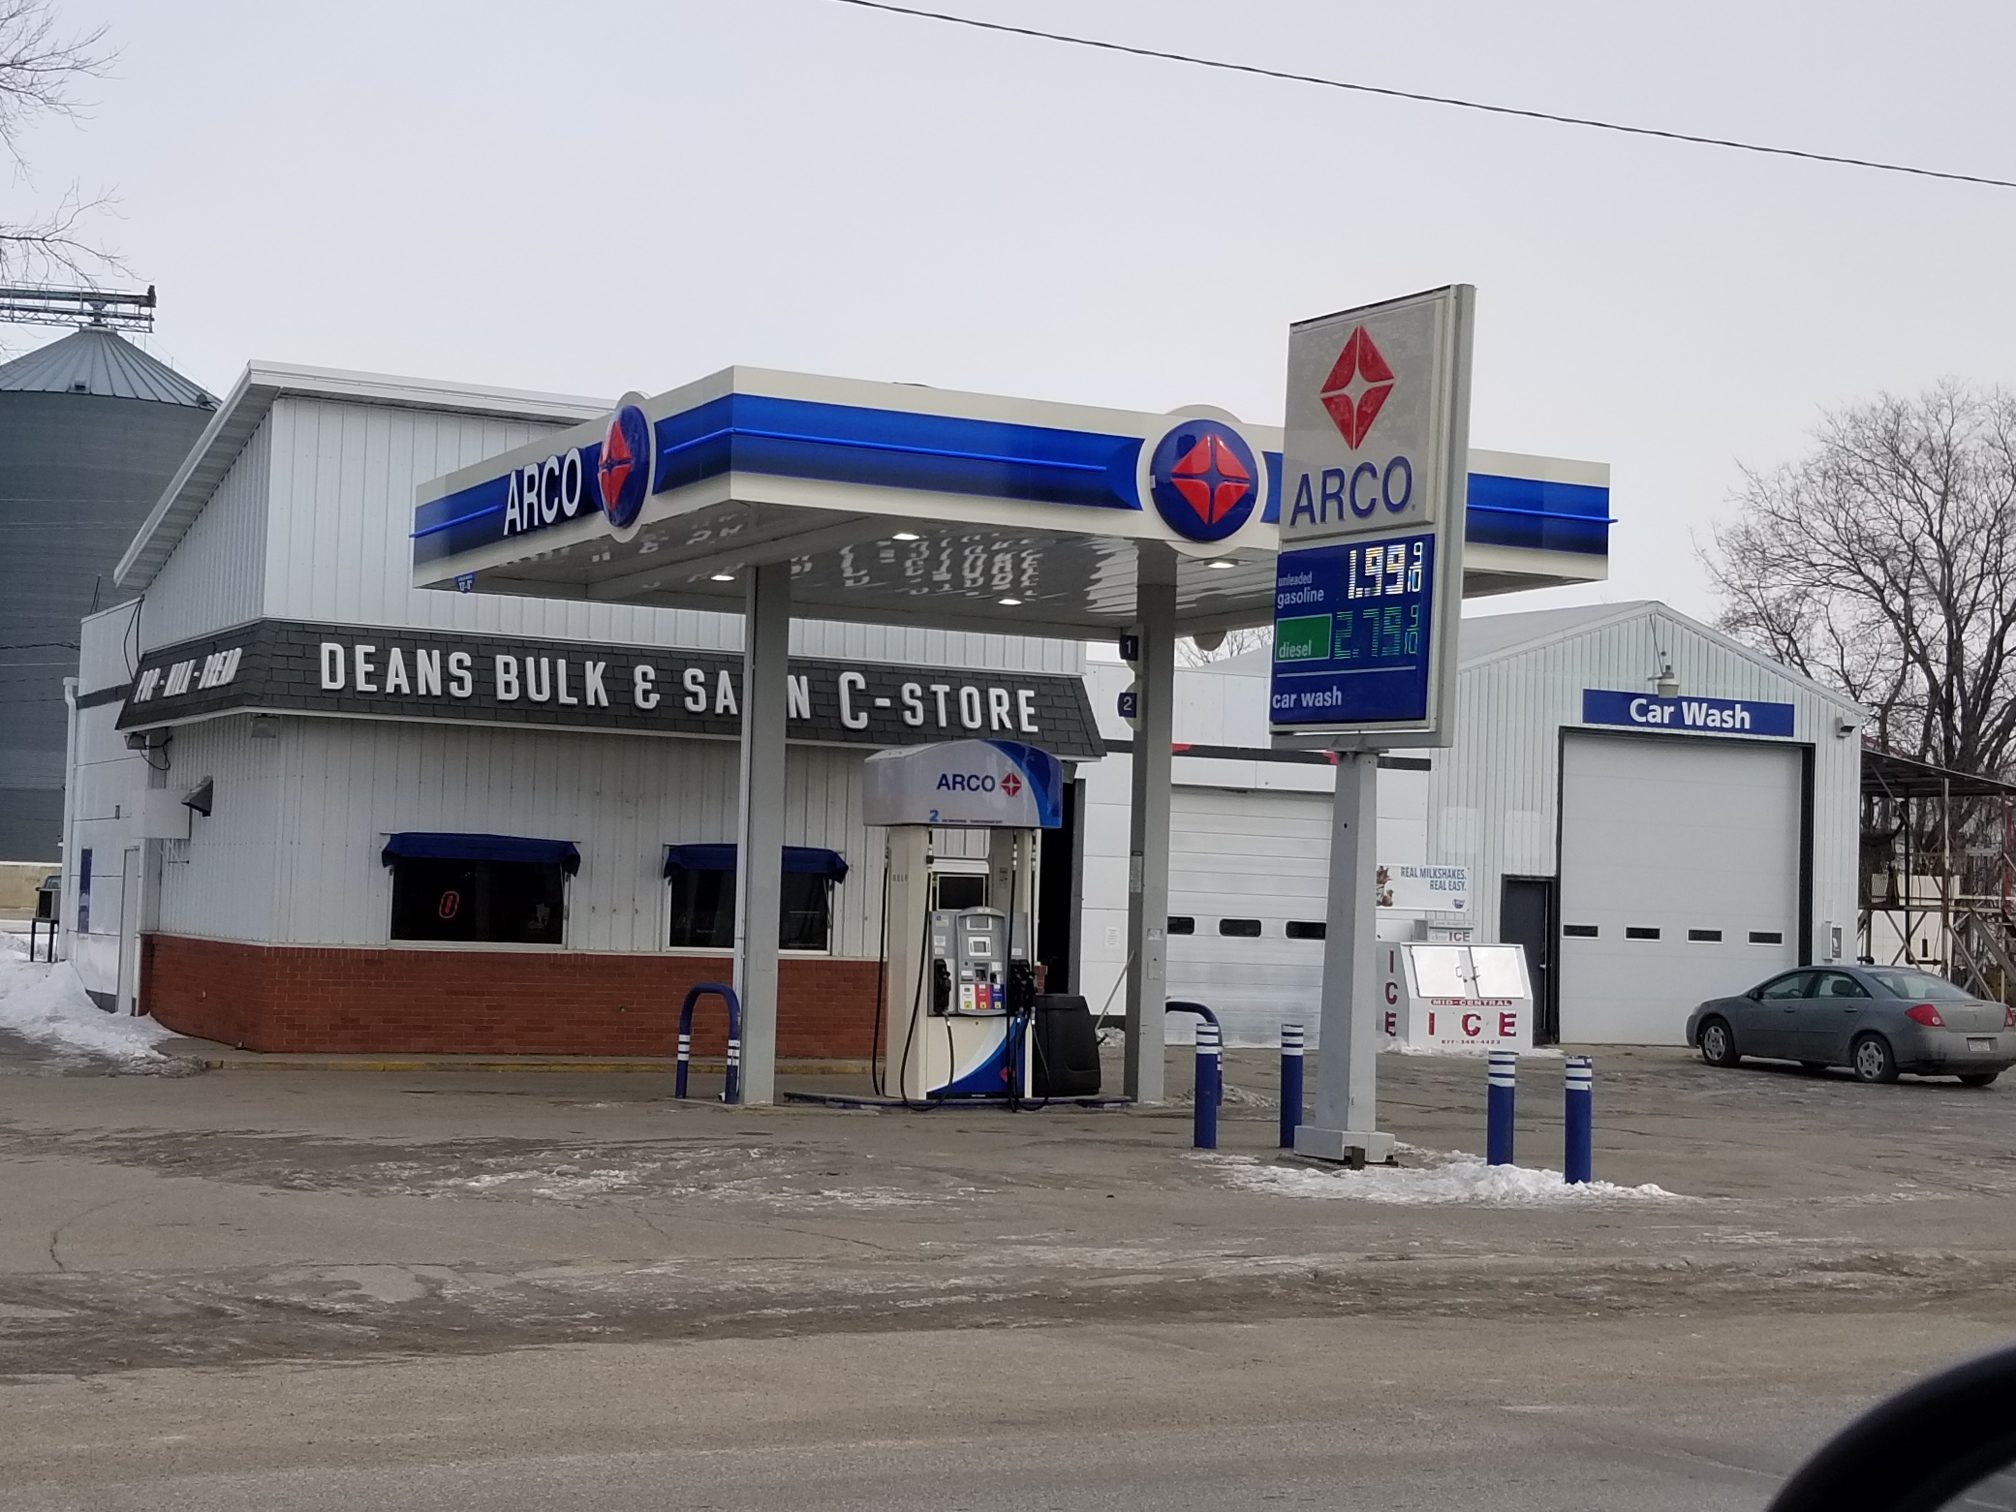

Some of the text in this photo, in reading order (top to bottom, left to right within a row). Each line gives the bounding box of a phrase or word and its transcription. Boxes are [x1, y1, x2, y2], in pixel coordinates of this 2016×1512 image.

[503, 447, 582, 536] ARCO
[1289, 455, 1413, 527] ARCO
[1278, 570, 1313, 586] unleaded
[1347, 544, 1406, 599] 1.99
[1277, 586, 1325, 609] gasoline
[1333, 605, 1402, 660] 2.79
[1125, 640, 1132, 654] 1
[1278, 639, 1312, 659] diesel
[320, 642, 1039, 733] DEANS BULK & SAN C-STORE
[1272, 685, 1343, 709] car wash
[1123, 696, 1133, 711] 2
[1629, 698, 1751, 729] Car Wash
[936, 773, 996, 793] ARCO
[928, 809, 940, 823] 2
[1401, 866, 1467, 880] REAL MILKSHAKES.
[1429, 880, 1467, 891] REAL EASY.
[1449, 931, 1471, 942] ICE
[1428, 1010, 1517, 1037] ICE
